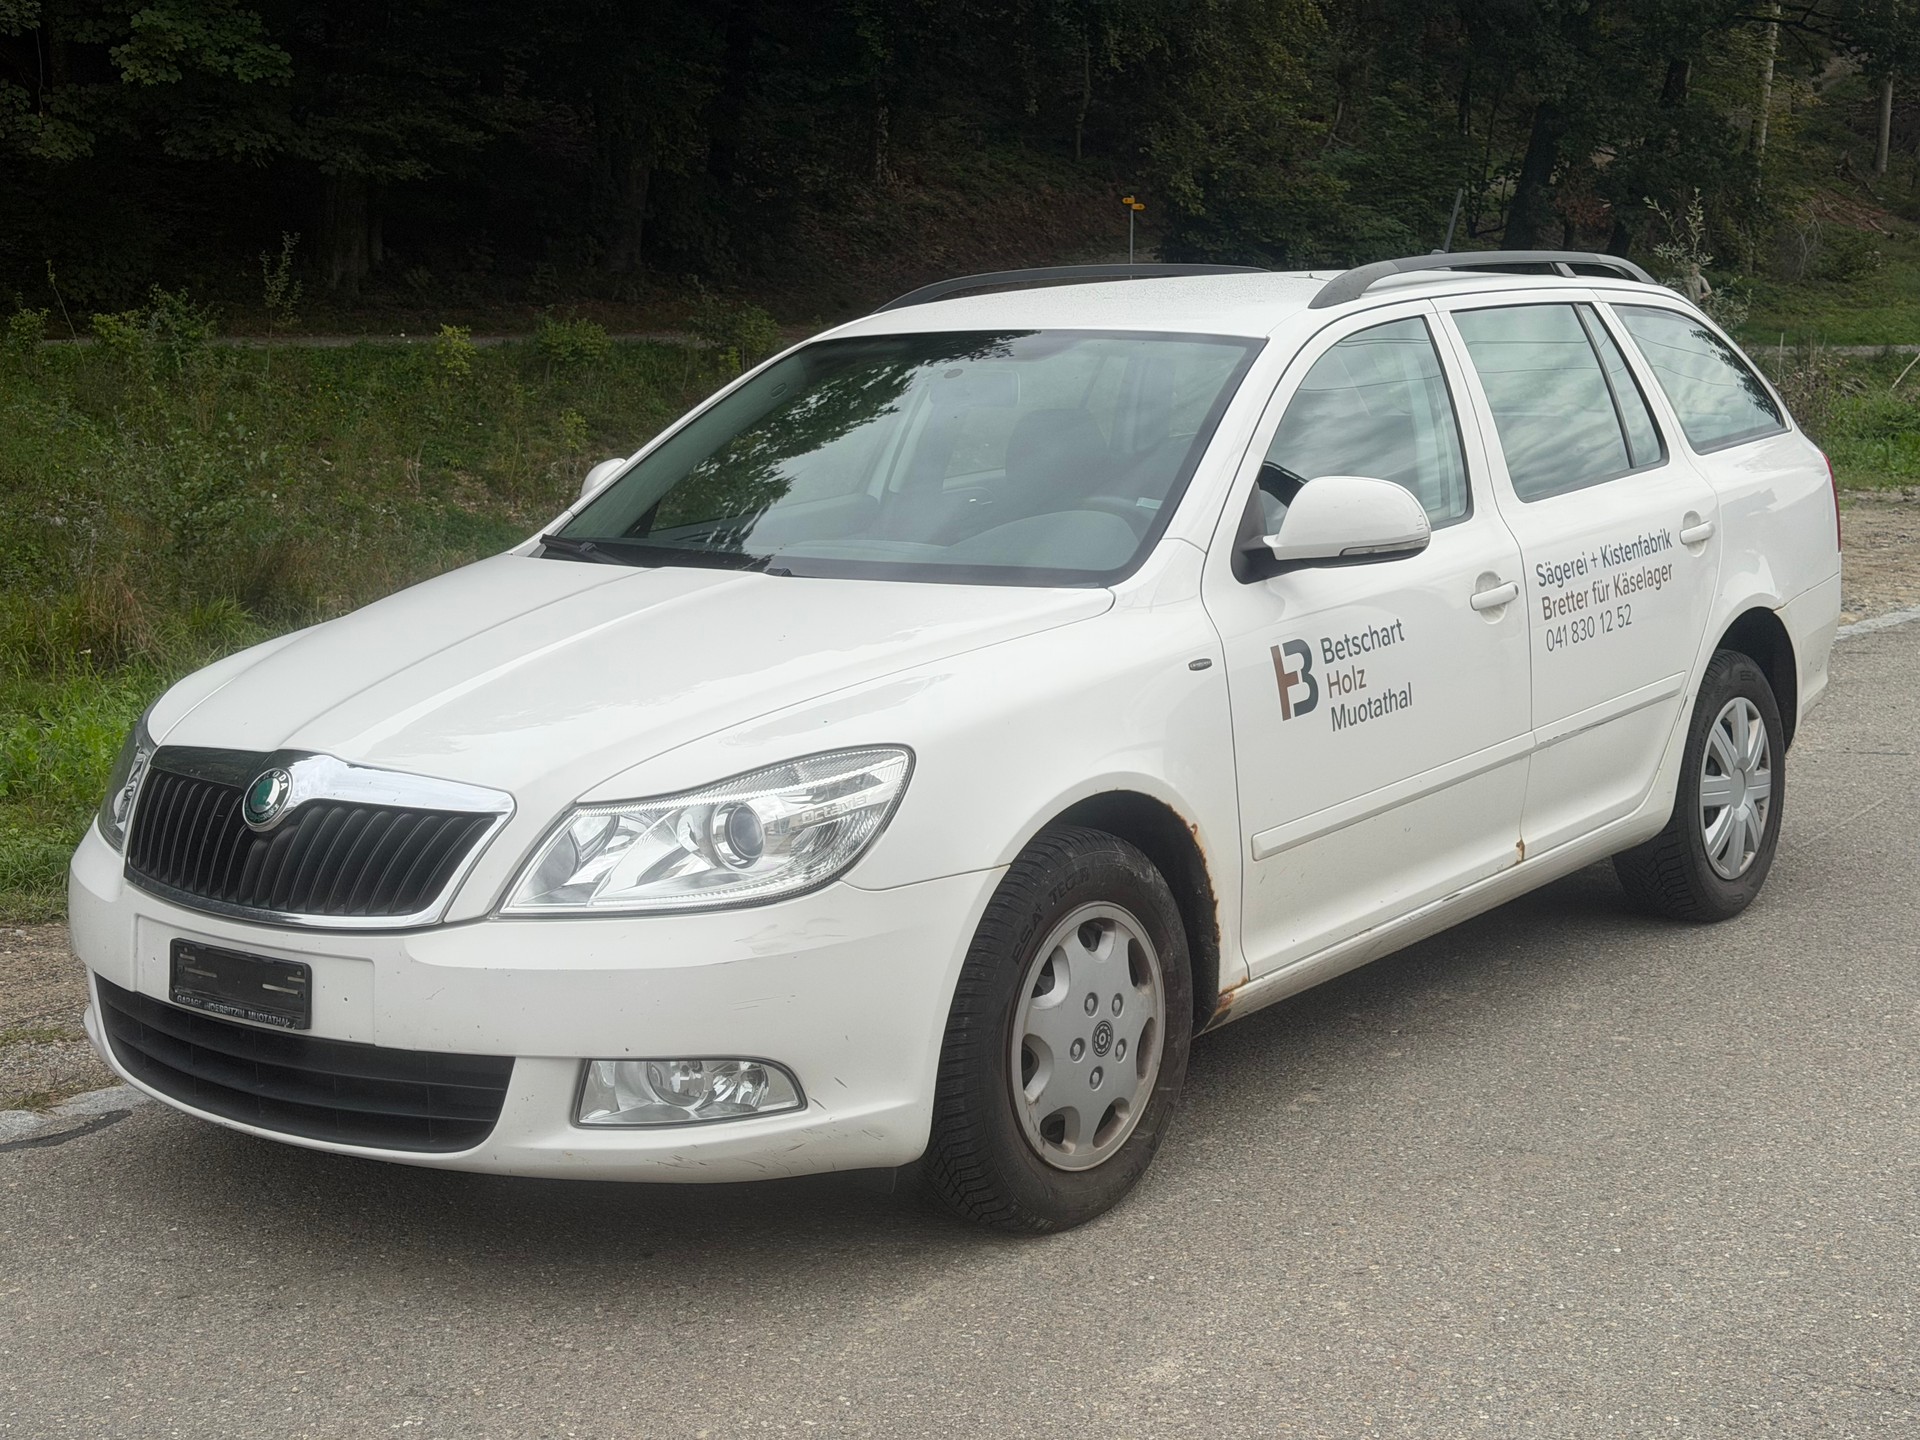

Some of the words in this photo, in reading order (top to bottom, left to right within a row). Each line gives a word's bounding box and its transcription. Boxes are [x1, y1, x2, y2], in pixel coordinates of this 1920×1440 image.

[1535, 551, 1588, 588] Sägerei
[1590, 552, 1598, 568] +
[1600, 528, 1673, 568] Kistenfabrik
[1541, 590, 1589, 621] Bretter
[1591, 579, 1610, 605] für
[1613, 563, 1673, 598] Käselager
[1320, 618, 1405, 665] Betschart
[1546, 624, 1568, 652] 041
[1571, 616, 1595, 644] 830
[1600, 610, 1614, 634] 12
[1617, 603, 1633, 628] 52
[1326, 665, 1367, 699] Holz
[1331, 682, 1413, 732] Muotathal
